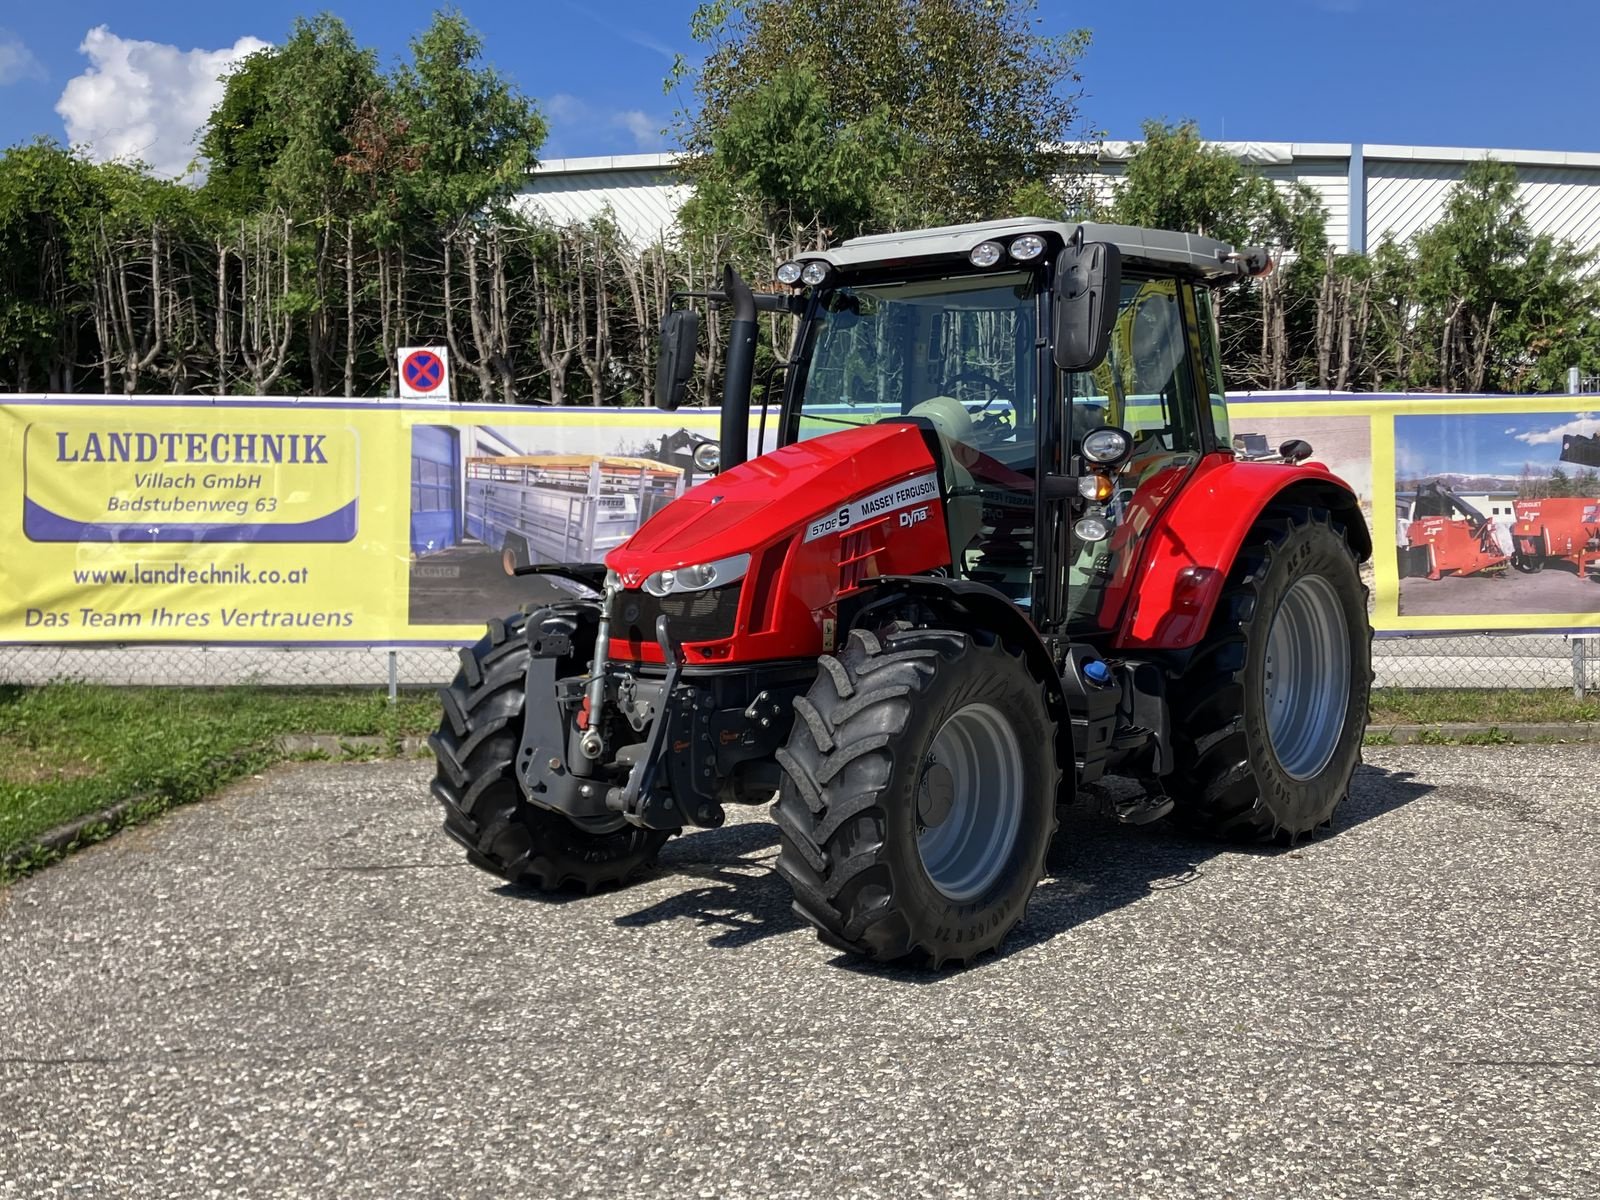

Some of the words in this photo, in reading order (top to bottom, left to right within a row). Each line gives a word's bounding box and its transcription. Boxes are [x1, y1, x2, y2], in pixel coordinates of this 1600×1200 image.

[56, 431, 329, 464] LANDTECHNIK
[134, 473, 196, 490] Villach
[202, 474, 261, 490] GmbH
[107, 496, 249, 516] Badstubenweg
[255, 497, 277, 512] 63
[861, 494, 894, 516] MASSEY
[896, 481, 936, 502] FERGUSON
[73, 563, 309, 586] www.landtechnik.co.at
[25, 608, 70, 627] Das
[79, 608, 142, 627] Team
[151, 608, 210, 627] Ihres
[220, 608, 354, 627] Vertrauens
